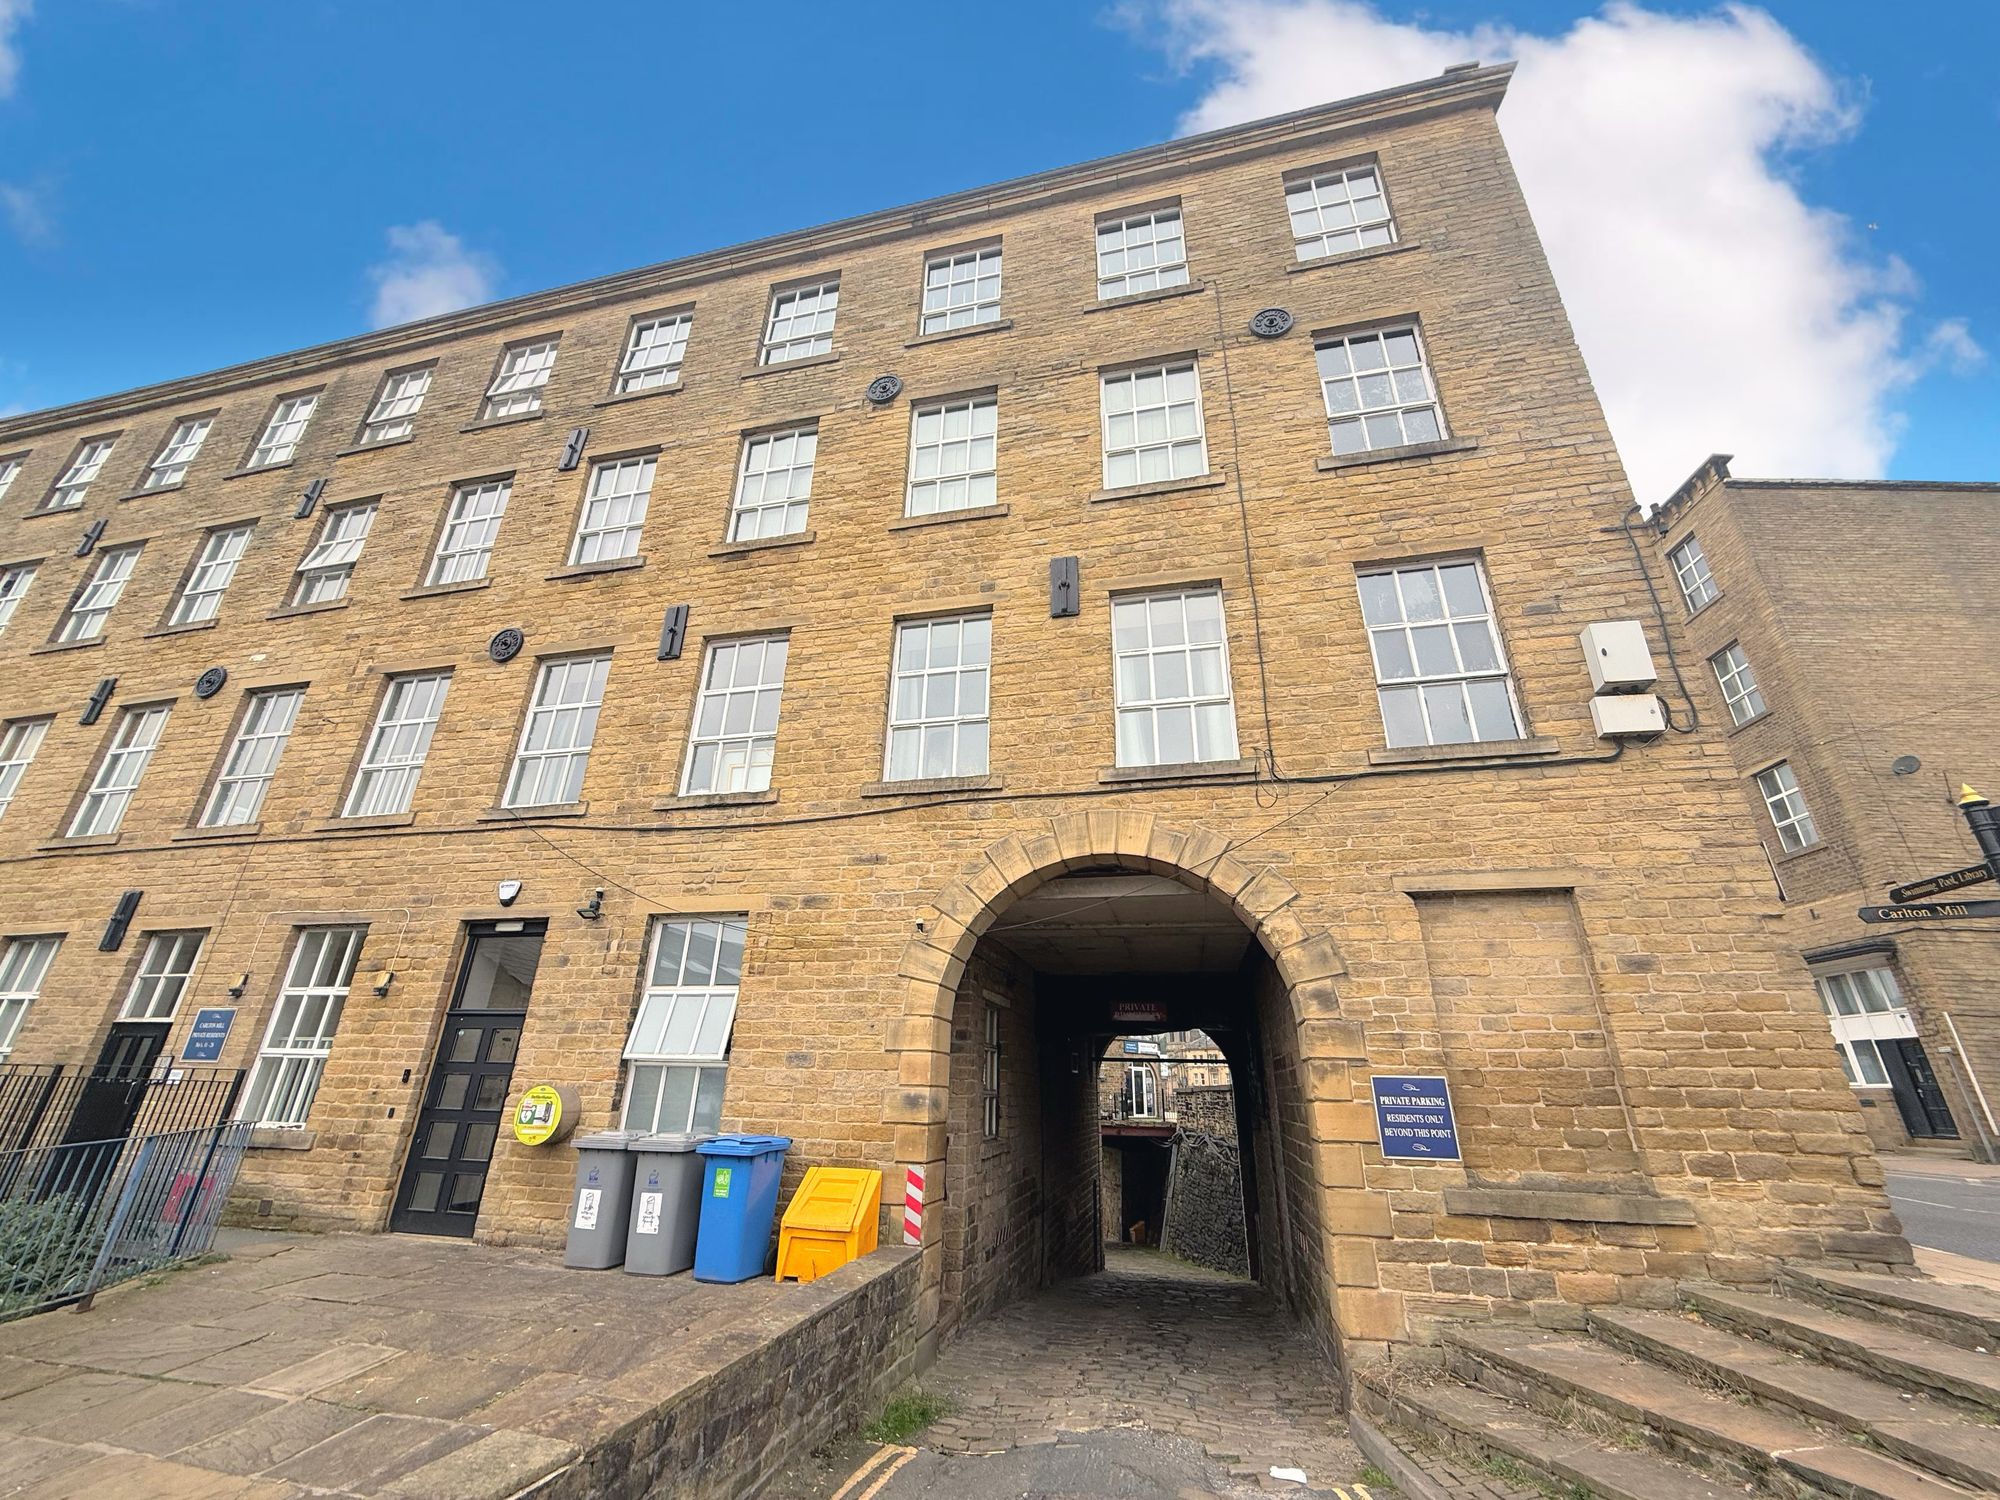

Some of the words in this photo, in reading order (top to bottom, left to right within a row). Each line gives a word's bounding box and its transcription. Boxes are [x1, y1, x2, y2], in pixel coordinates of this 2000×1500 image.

[1957, 869, 1987, 883] Library
[1878, 908, 1931, 920] Carlton
[1936, 905, 1968, 917] Mill
[1119, 1003, 1157, 1011] PRIVATE
[1380, 1096, 1411, 1106] PRIVATE
[1412, 1097, 1445, 1106] PARKING
[1386, 1113, 1424, 1124] RESIDENTS
[1425, 1114, 1444, 1124] ONLY
[1384, 1127, 1413, 1137] BEYOND
[1413, 1128, 1430, 1138] THIS
[1430, 1129, 1452, 1138] POINT
